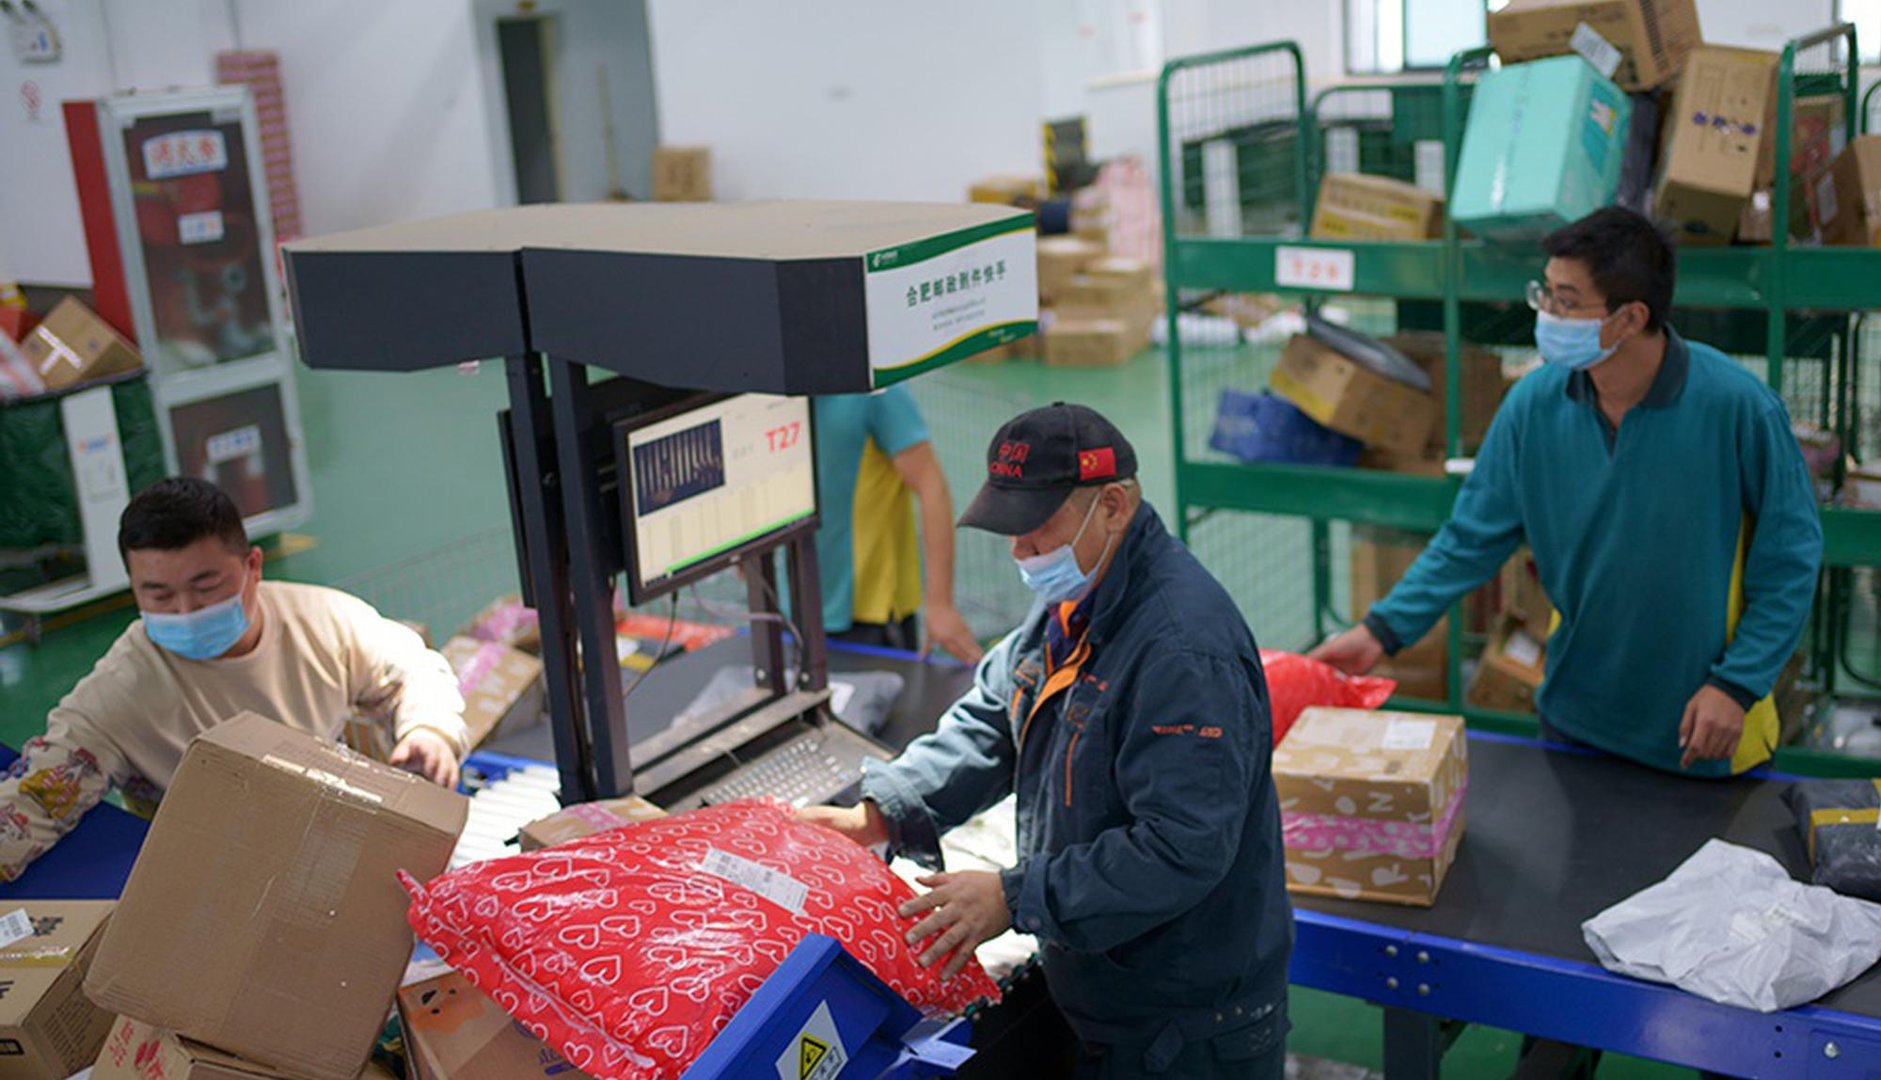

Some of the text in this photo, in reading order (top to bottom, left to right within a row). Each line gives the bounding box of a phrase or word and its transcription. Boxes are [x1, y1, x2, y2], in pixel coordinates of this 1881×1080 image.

[765, 421, 800, 453] T27
[999, 442, 1030, 463] 中国
[989, 462, 1023, 479] CHINA
